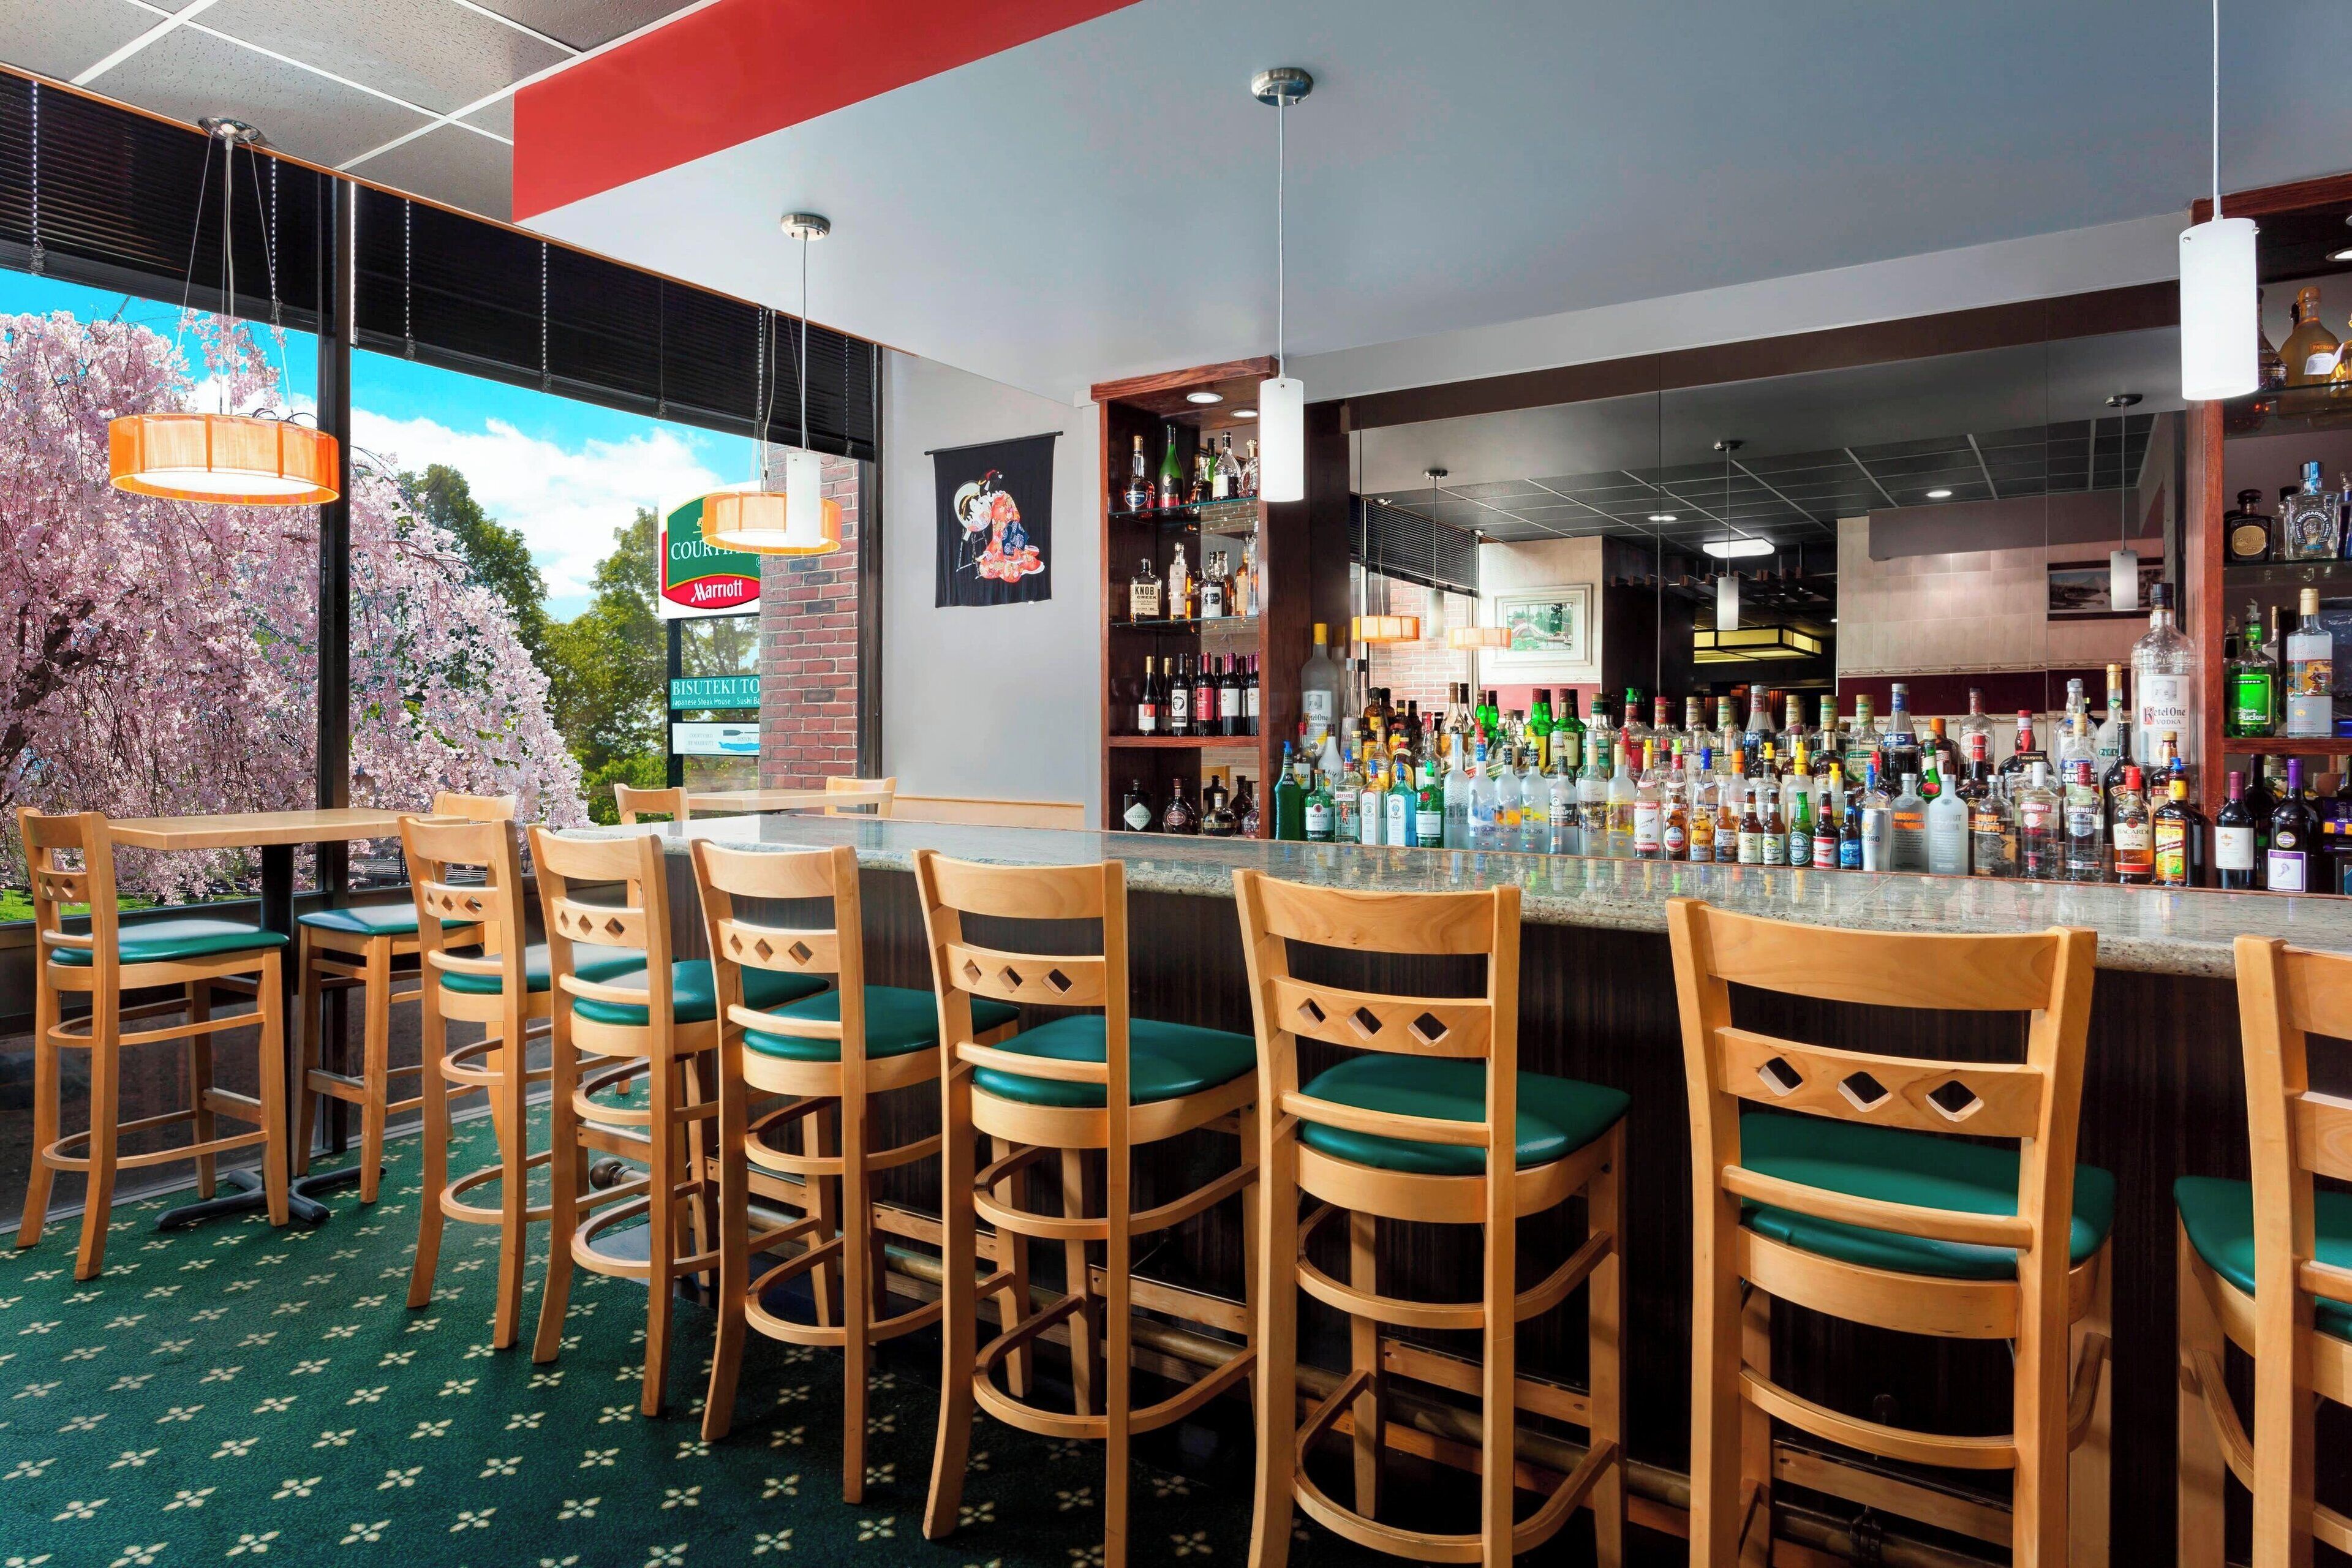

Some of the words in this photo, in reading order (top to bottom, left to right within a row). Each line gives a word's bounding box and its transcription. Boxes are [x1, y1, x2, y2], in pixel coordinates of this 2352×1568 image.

[690, 579, 743, 603] Marriott
[1135, 586, 1154, 595] KNOB
[672, 679, 736, 695] BISUTEKI
[2144, 707, 2168, 722] Ketel
[2170, 707, 2185, 716] One
